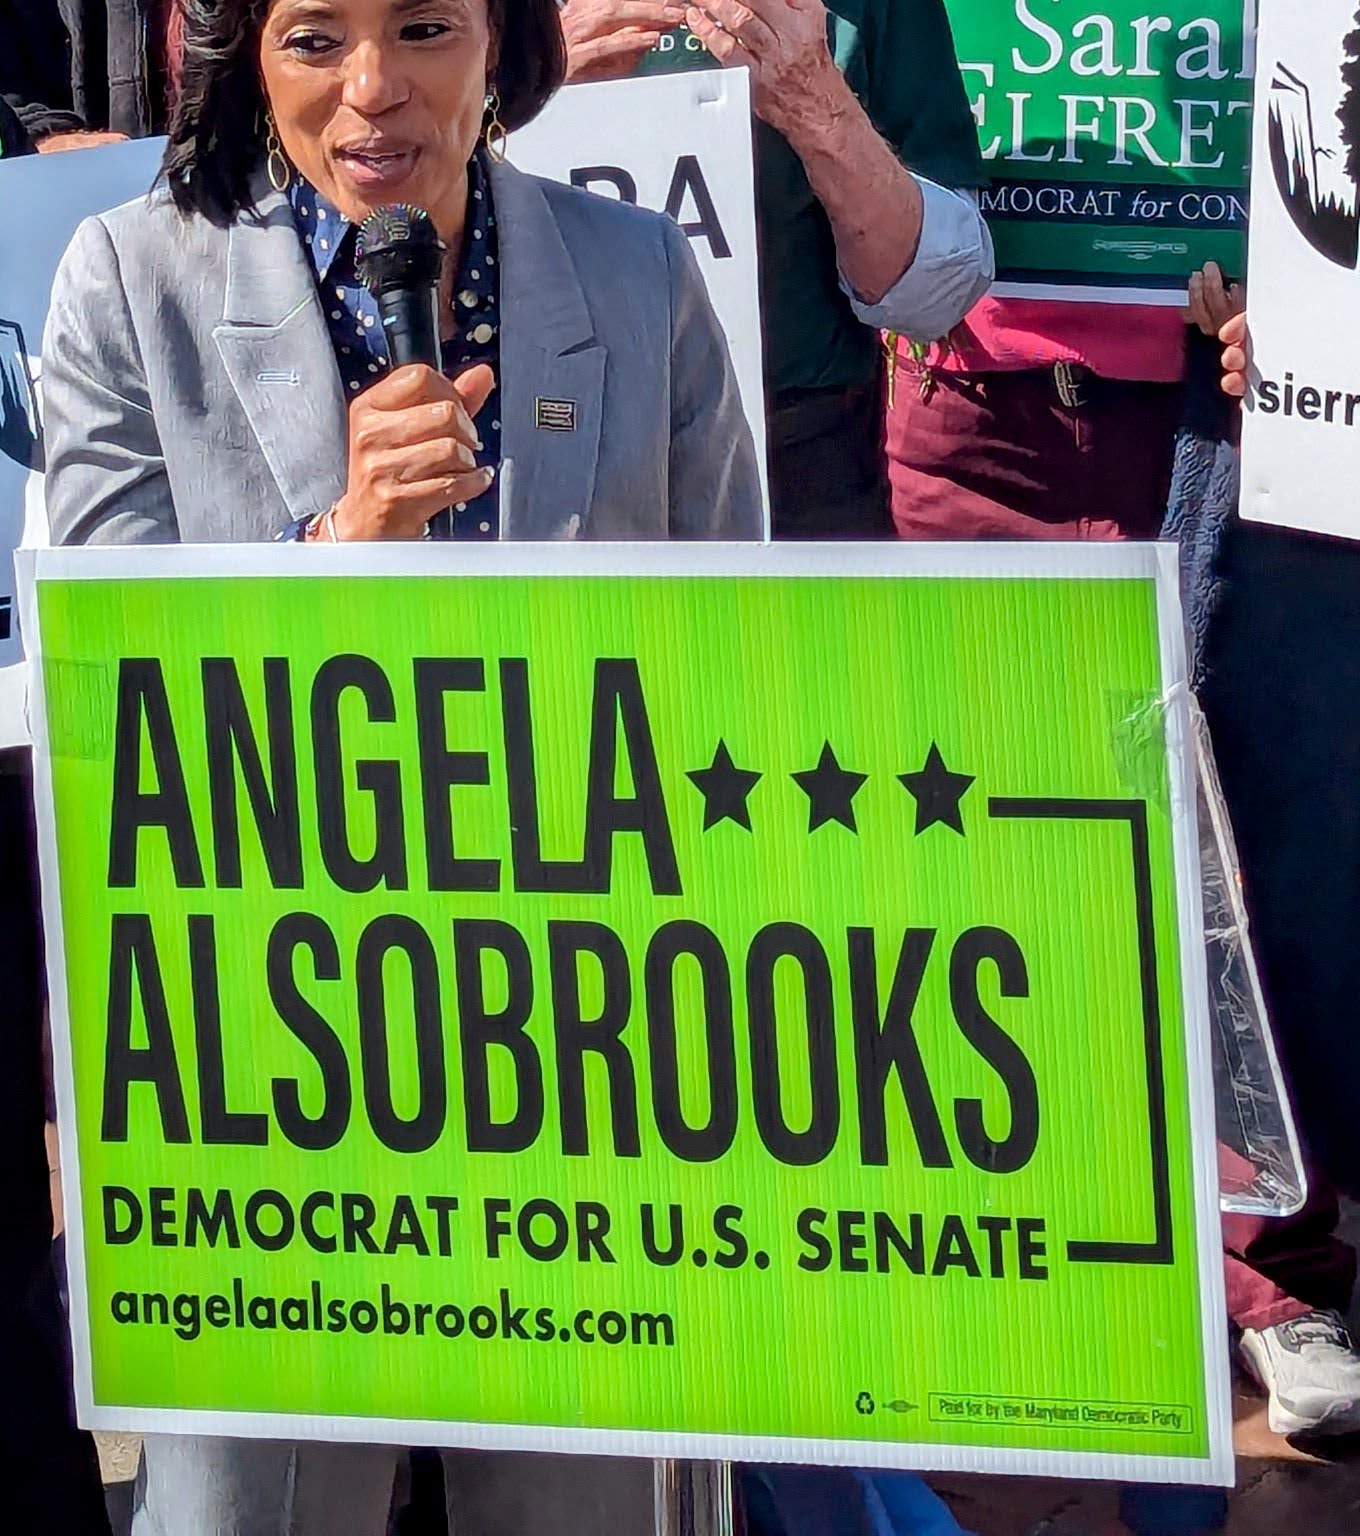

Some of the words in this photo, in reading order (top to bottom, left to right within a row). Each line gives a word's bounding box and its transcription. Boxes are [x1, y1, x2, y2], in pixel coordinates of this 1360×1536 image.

[958, 62, 1253, 171] ELFRE
[980, 187, 1121, 216] MOCRAT
[1129, 190, 1175, 219] for
[107, 654, 683, 896] ANGELA
[100, 911, 1040, 1174] ALSOBROOKS
[102, 1185, 460, 1258] DEMOCRAT
[485, 1197, 619, 1264] FOR
[641, 1203, 771, 1271] U.S.
[796, 1208, 1050, 1281] SENATE
[111, 1279, 675, 1348] angelaalsobrooks.com
[1152, 1409, 1183, 1430] Party
